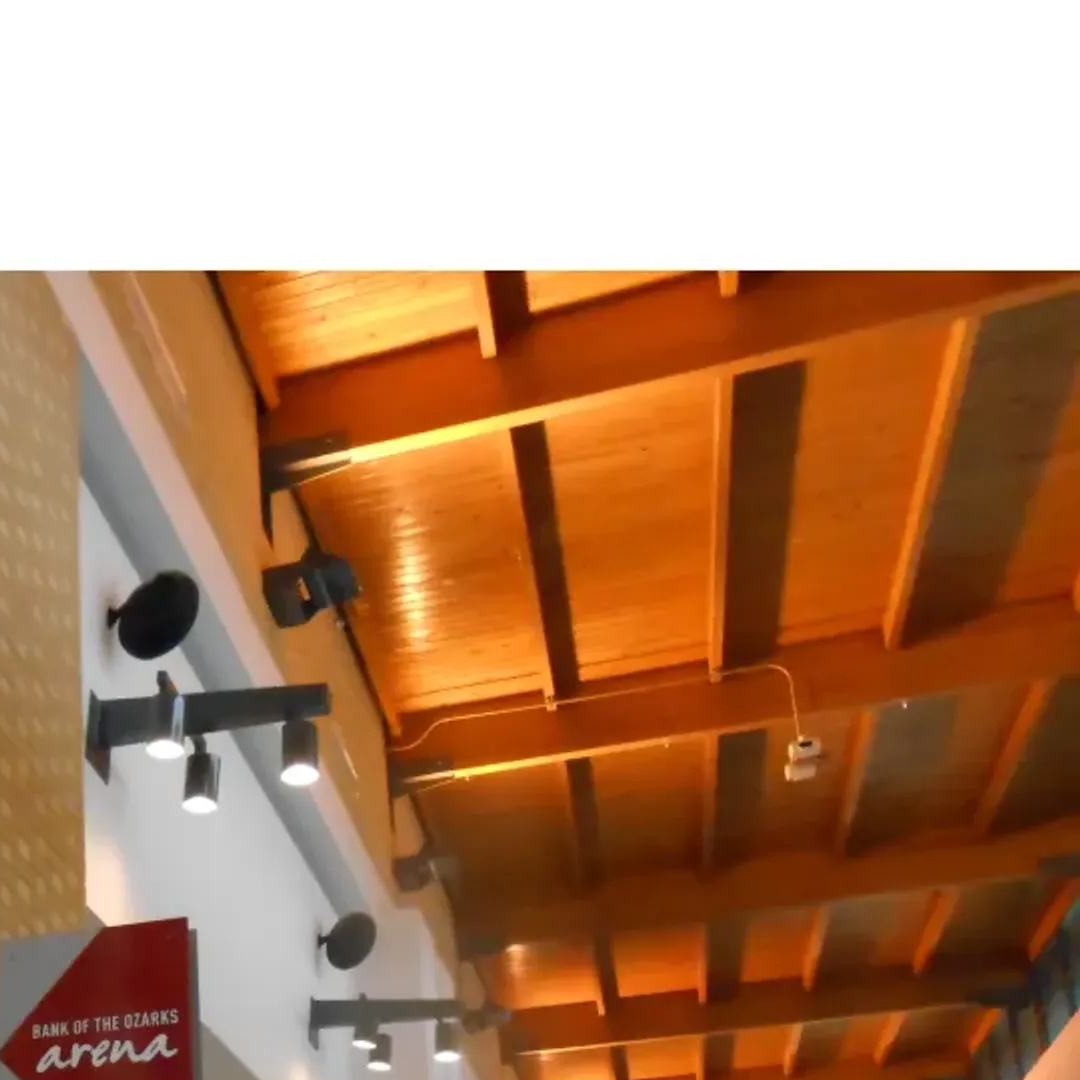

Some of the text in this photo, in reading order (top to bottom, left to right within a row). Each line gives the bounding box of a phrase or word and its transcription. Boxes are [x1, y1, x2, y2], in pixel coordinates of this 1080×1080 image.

[32, 1008, 180, 1039] BANK OF THE OZARKS
[35, 1032, 179, 1074] arena
